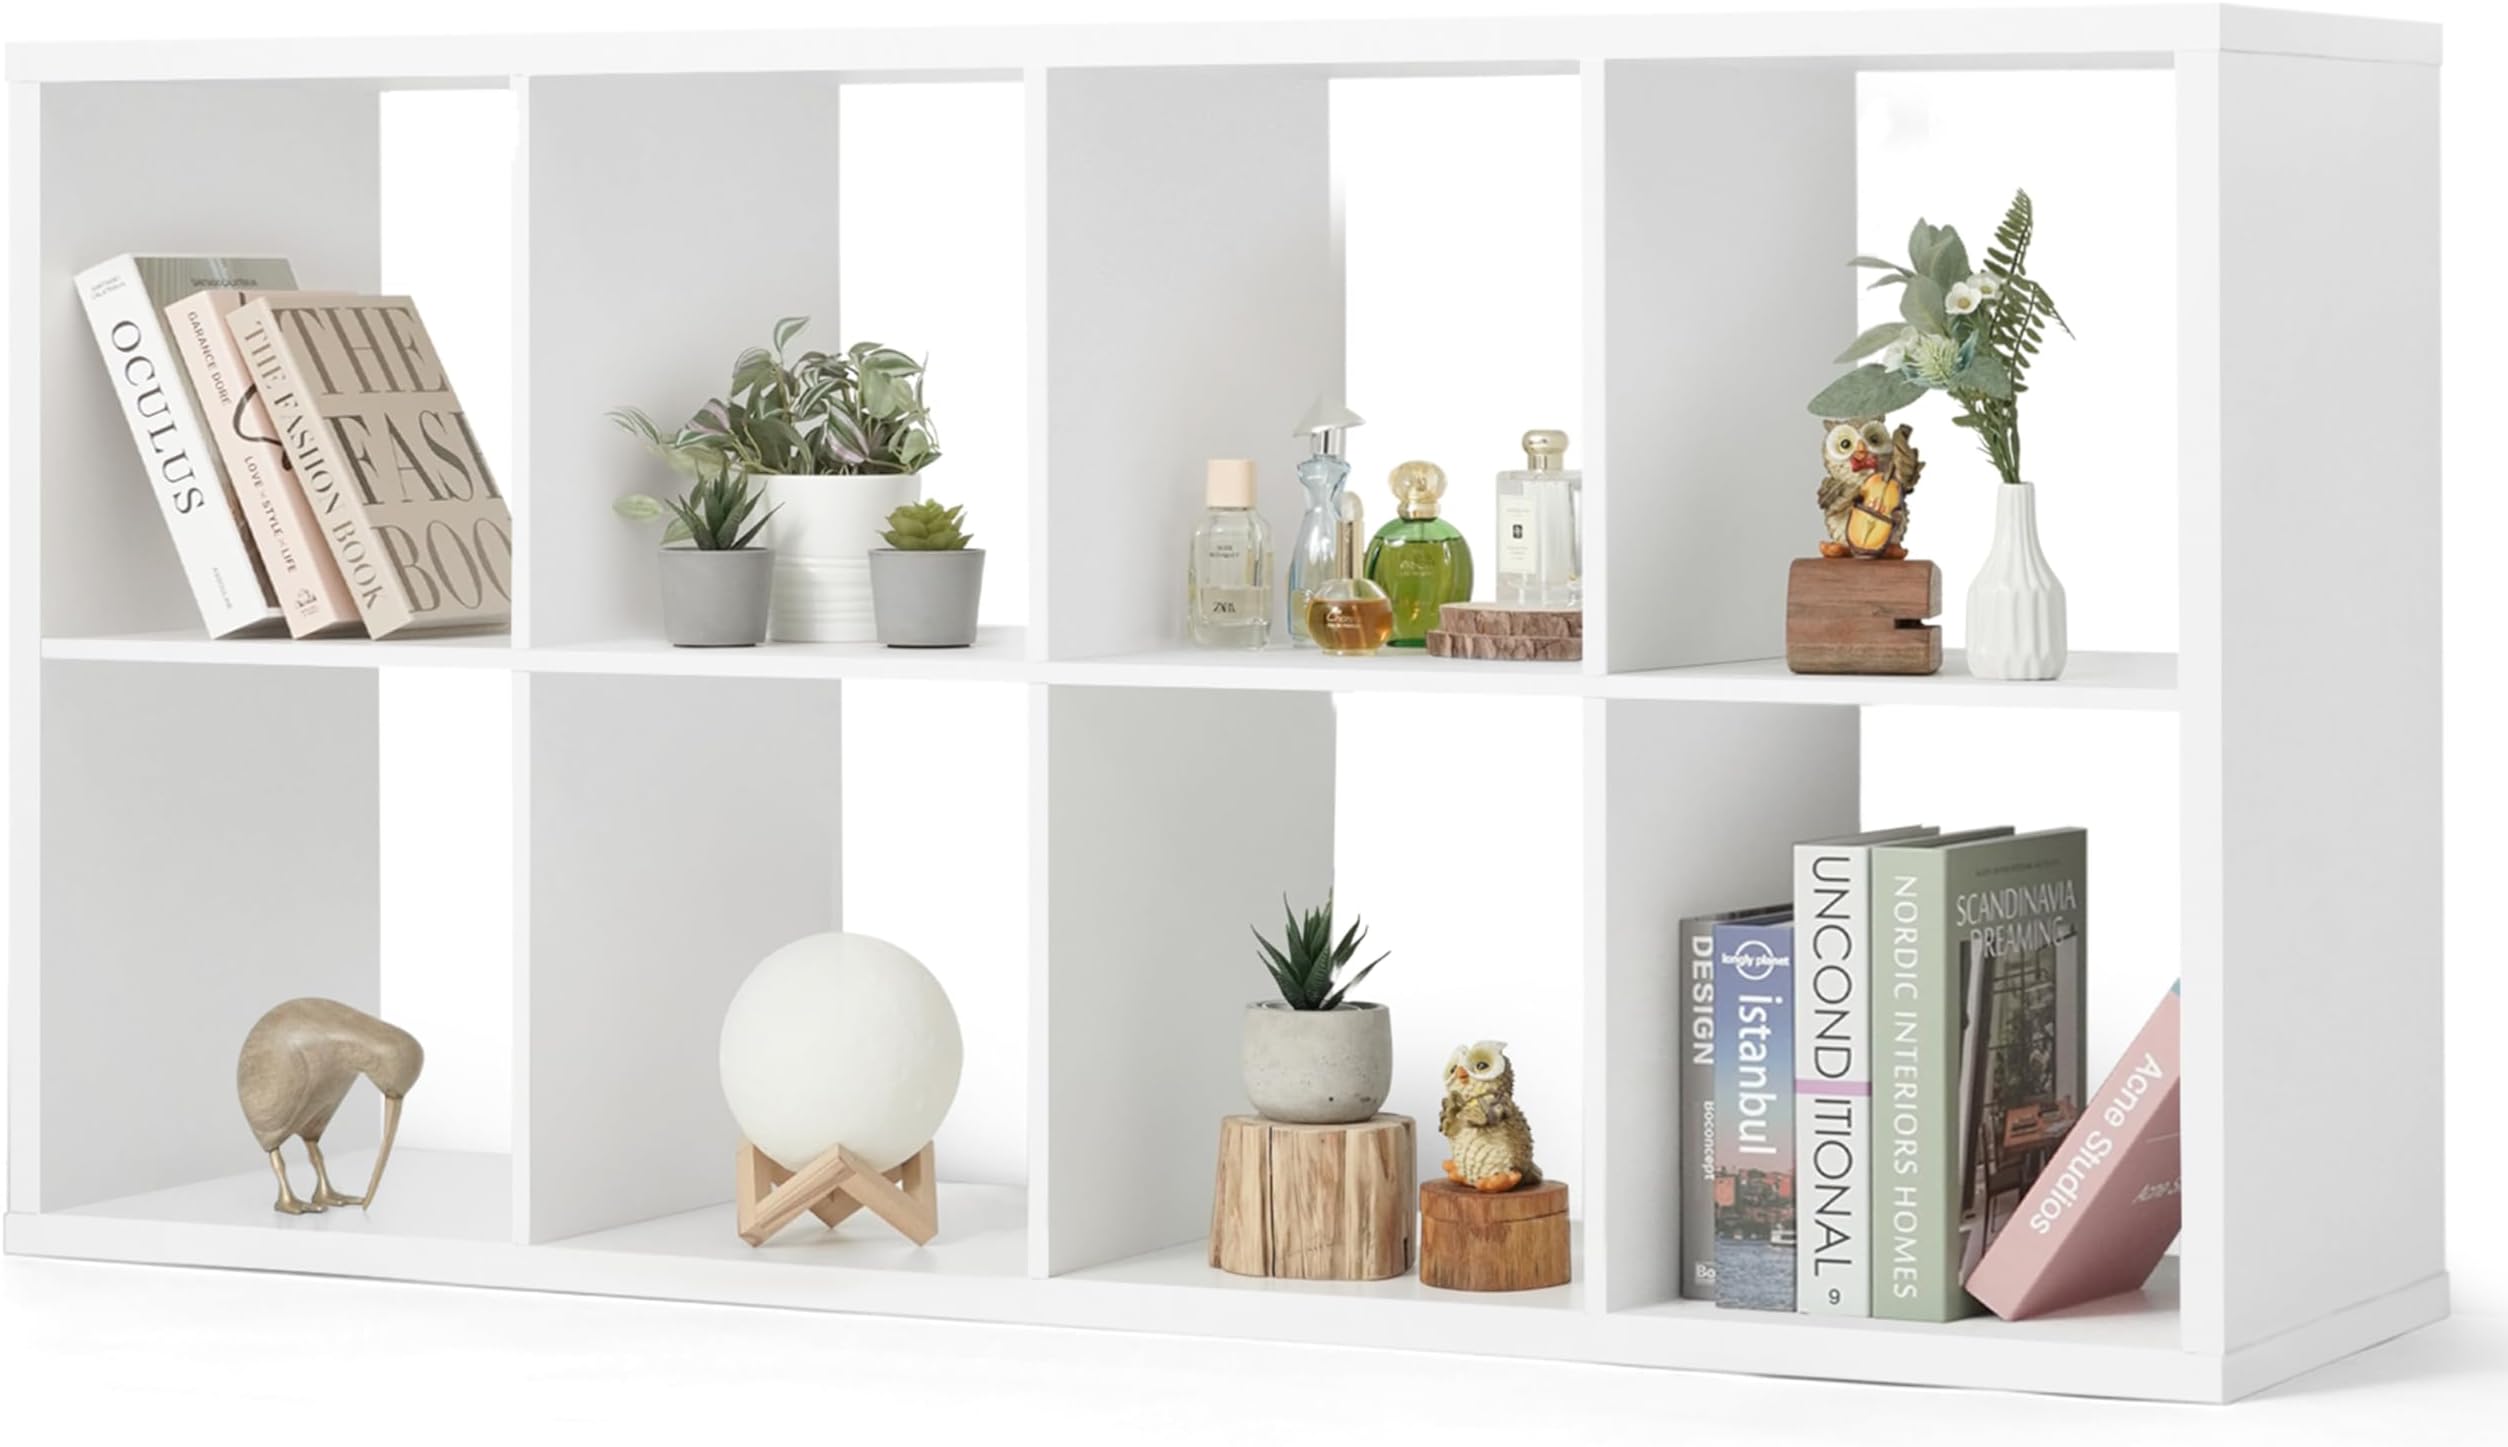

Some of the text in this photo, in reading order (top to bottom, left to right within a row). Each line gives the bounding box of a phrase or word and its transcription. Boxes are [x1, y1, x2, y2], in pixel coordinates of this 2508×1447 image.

[187, 311, 217, 370] GARANCE
[272, 306, 450, 394] THE
[112, 320, 205, 515] OCULUS
[245, 320, 385, 610] THE FASHION BOOK
[244, 456, 297, 574] LOVE STYLE LIFE
[1956, 880, 2077, 927] SCANDINAVIA
[1970, 915, 2065, 960] DREAMING
[1692, 936, 1714, 1065] DESIGN
[1755, 954, 1790, 967] planet
[1738, 995, 1783, 1155] istanbul
[1893, 875, 1918, 1299] NORDIC INTERIORS HOMES
[2103, 1053, 2164, 1128] Acne
[2030, 1135, 2114, 1236] Studios
[1828, 1288, 1841, 1305] 9
